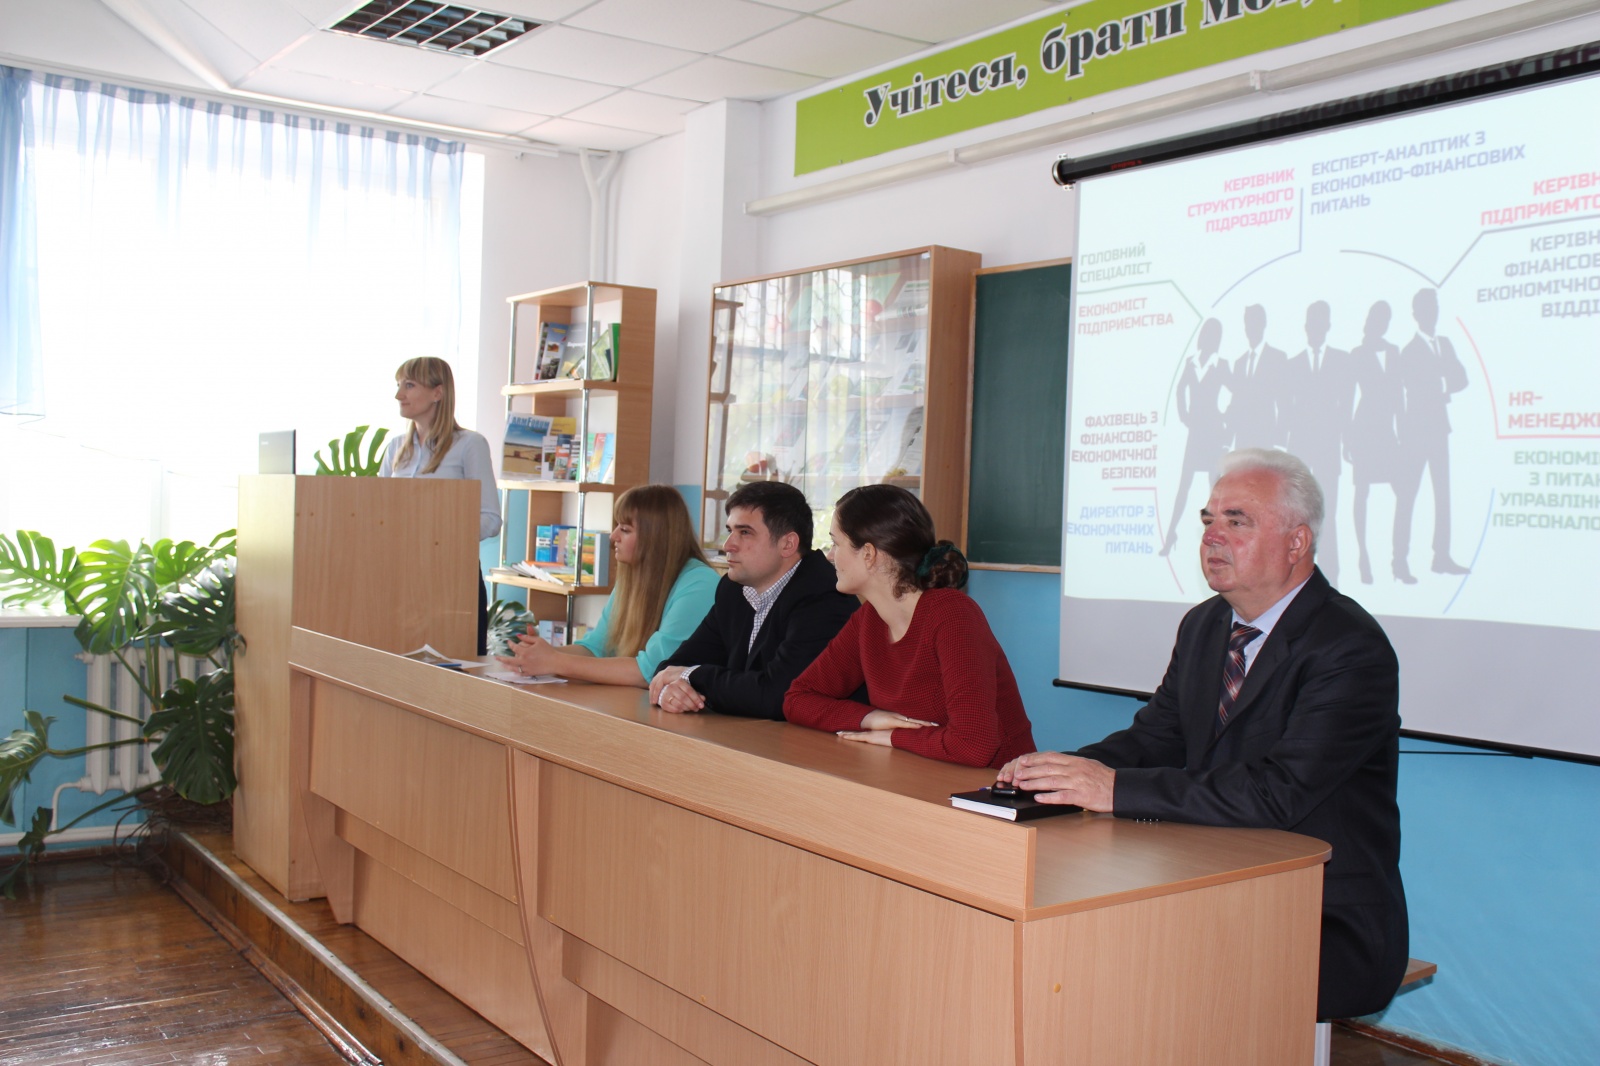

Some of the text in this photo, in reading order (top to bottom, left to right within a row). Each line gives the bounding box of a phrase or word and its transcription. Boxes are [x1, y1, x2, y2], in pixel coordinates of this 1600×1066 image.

[864, 1, 1186, 125] Учітеся, брати
[1312, 133, 1470, 176] ЕКСПЕРТ-АНАЛІТИК
[1224, 168, 1295, 192] КЕРІВНИК
[1311, 145, 1525, 195] ЕКОНОМІКО-ФІНАНСОВИХ
[1188, 187, 1294, 217] СТРУКТУРНОГО
[1311, 194, 1371, 215] ПИТАНЬ
[1206, 206, 1294, 233] ПІДРОЗДІЛУ
[1080, 242, 1146, 266] ГОЛОВНИЙ
[1080, 261, 1152, 284] СПЕЦІАЛІСТ
[1477, 275, 1600, 303] ЕКОНОМІЧНО
[1078, 297, 1148, 318] ЕКОНОМІСТ
[1078, 312, 1174, 336] ПІДПРИЄМСТВА
[1508, 391, 1543, 406] HR-
[1085, 412, 1147, 428] ФАХІВЕЦЬ
[1508, 412, 1600, 430] МЕНЕДЖ
[1080, 430, 1158, 445] ФІНАНСОВО-
[1071, 445, 1157, 463] ЕКОНОМІЧНОЇ
[1514, 450, 1600, 466] ЕКОНОМІ
[1102, 466, 1156, 480] БЕЗПЕКИ
[1080, 505, 1144, 520] ДИРЕКТОР
[1066, 522, 1154, 536] ЕКОНОМІЧНИХ
[1105, 541, 1153, 554] ПИТАНЬ
